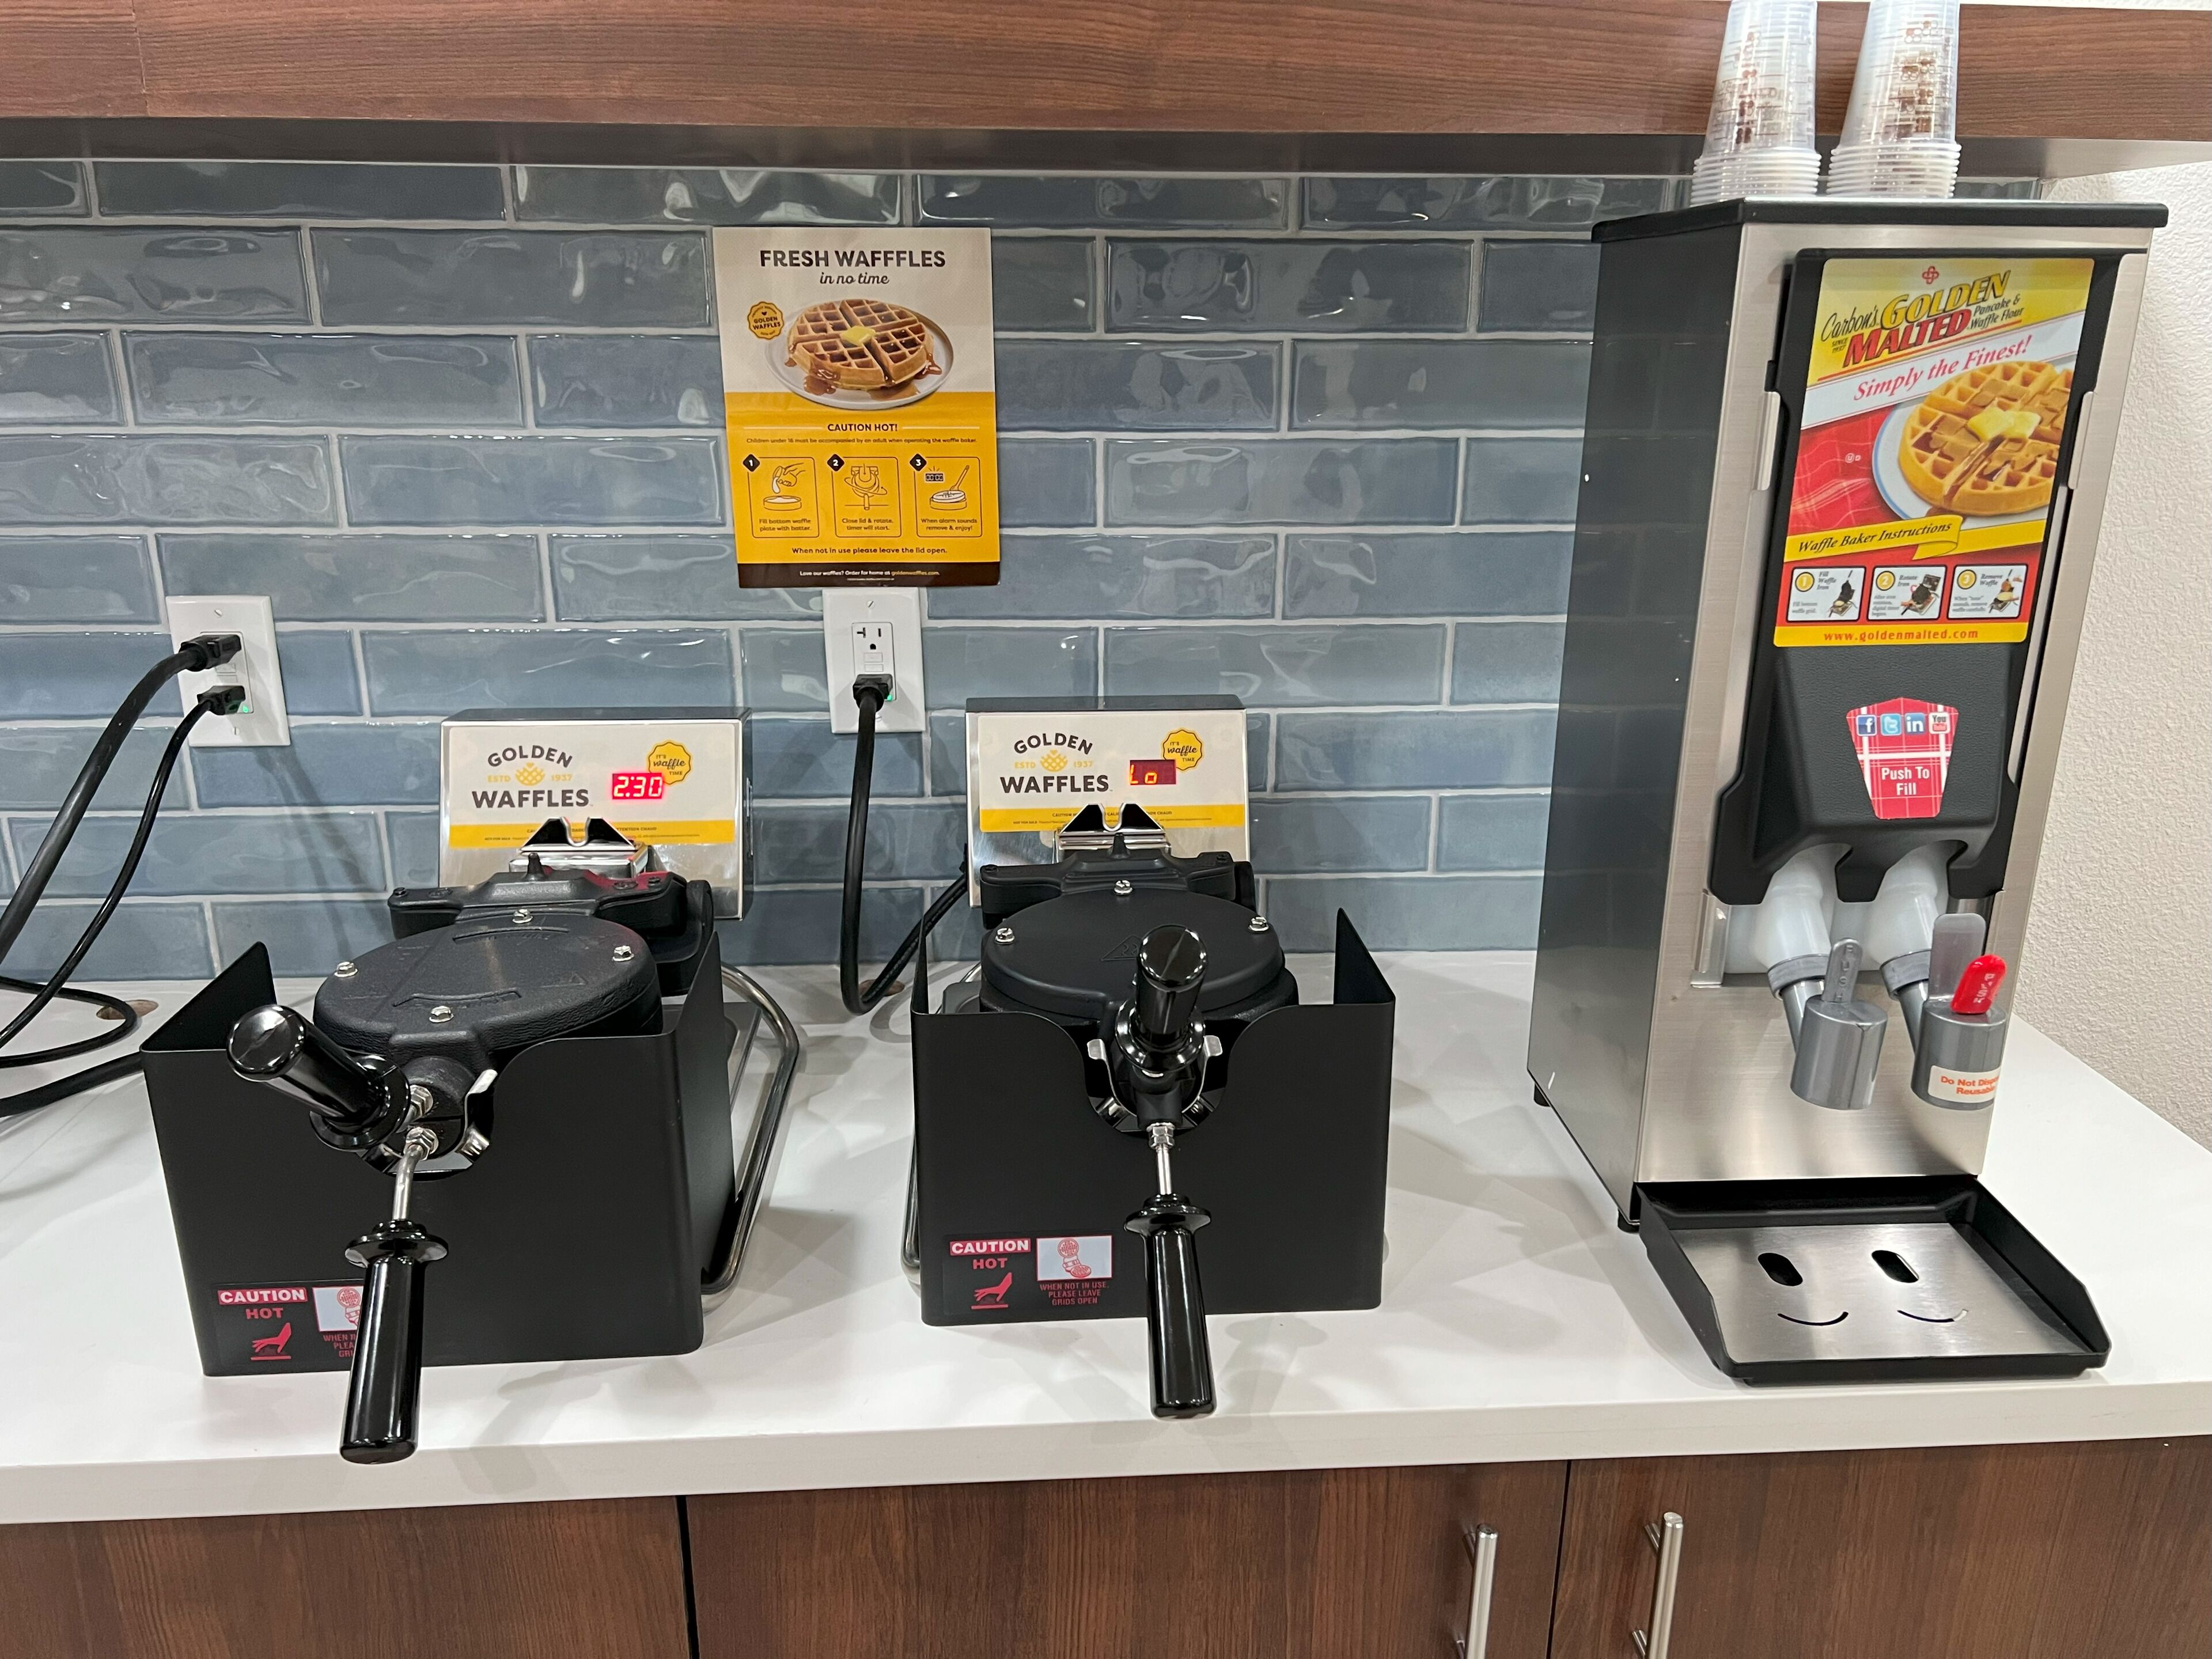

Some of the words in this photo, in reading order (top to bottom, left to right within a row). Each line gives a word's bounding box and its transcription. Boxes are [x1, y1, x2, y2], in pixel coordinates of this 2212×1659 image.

[760, 250, 830, 267] FRESH
[834, 250, 946, 267] WAFFFLES
[820, 272, 835, 284] in
[836, 275, 856, 285] no
[857, 272, 890, 285] time
[1821, 305, 1878, 342] Carbon's
[1880, 270, 2012, 330] GOLDEN
[1974, 298, 2012, 317] Pancake
[2013, 293, 2021, 305] &
[752, 321, 781, 330] WAFFLES
[1970, 313, 1999, 330] Waffle
[2001, 308, 2024, 321] Flour
[1842, 309, 1972, 368] MALTED
[1854, 367, 1923, 401] Simply
[1927, 353, 1959, 381] the
[1961, 334, 2032, 370] Finest!
[827, 423, 872, 431] CAUTION
[874, 423, 897, 431] HOT!
[1798, 536, 1839, 553] Waffle
[1839, 533, 1878, 547] Baker
[1878, 522, 1953, 541] Instructions
[1881, 577, 1889, 585] 2
[1824, 629, 1979, 642] www.goldenmalted.com
[1932, 715, 1946, 723] You
[1014, 733, 1093, 755] GOLDEN
[1167, 745, 1198, 756] waffle
[488, 745, 573, 768] GOLDEN
[653, 759, 686, 770] waffle
[551, 774, 573, 782] 1937
[1881, 767, 1912, 780] Push
[1915, 767, 1930, 779] To
[1000, 775, 1109, 793] WAFFLES
[1896, 783, 1917, 796] Fill
[471, 789, 589, 809] WAFFLES
[1941, 1075, 1955, 1084] Do
[1957, 1078, 1976, 1086] Not
[951, 1240, 1029, 1254] CAUTION
[972, 1258, 1008, 1270] HOT
[220, 1289, 305, 1303] CAUTION
[245, 1308, 283, 1319] HOT
[334, 1342, 355, 1350] PLEA
[339, 1350, 354, 1358] GRI
